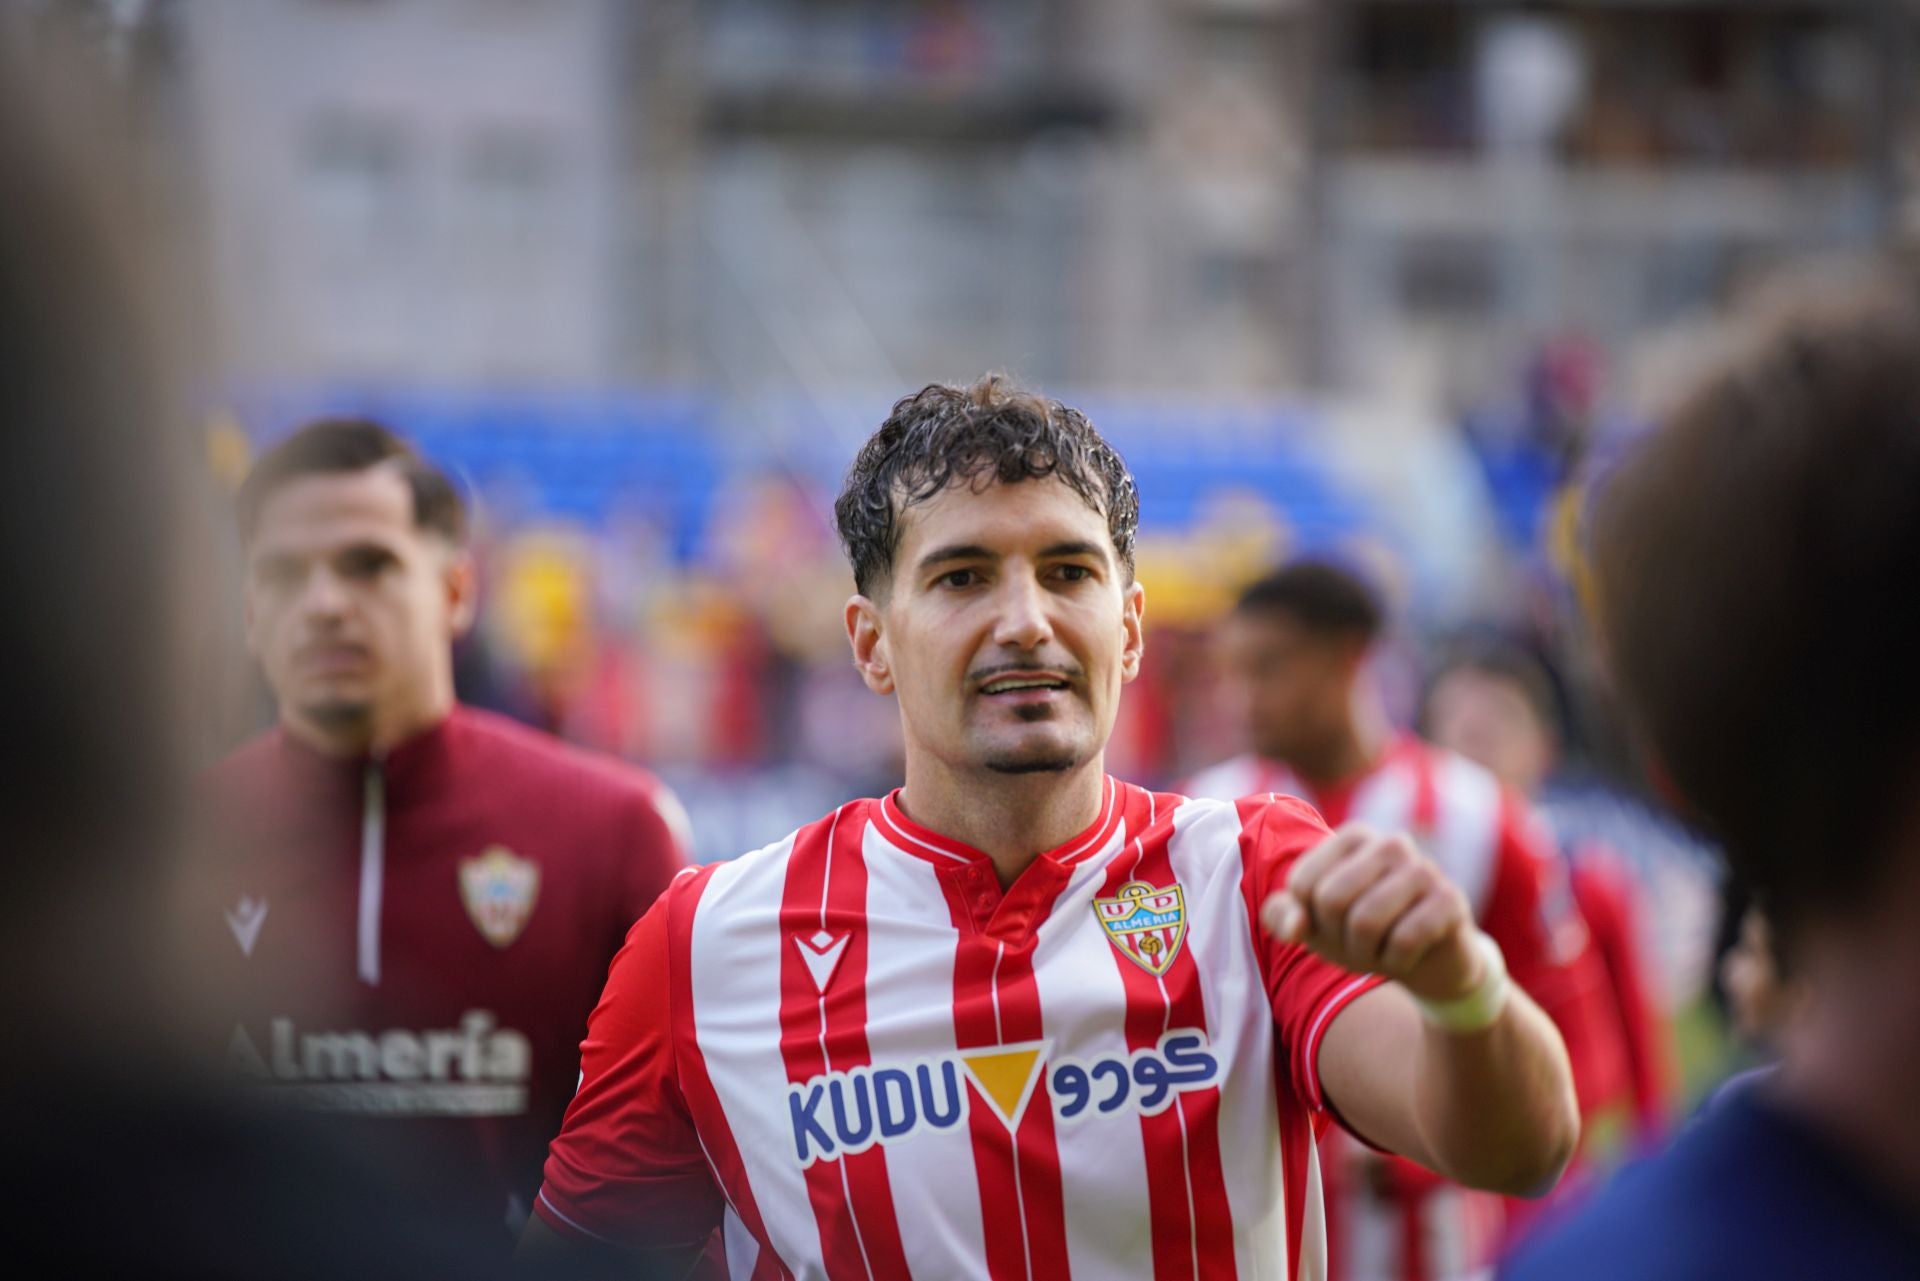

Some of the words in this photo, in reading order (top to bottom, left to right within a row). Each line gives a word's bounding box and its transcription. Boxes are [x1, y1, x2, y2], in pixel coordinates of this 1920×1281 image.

[1106, 904, 1123, 916] U
[1155, 896, 1172, 908] D
[789, 1061, 961, 1160] KUDU
[1053, 1036, 1217, 1117] كودو
